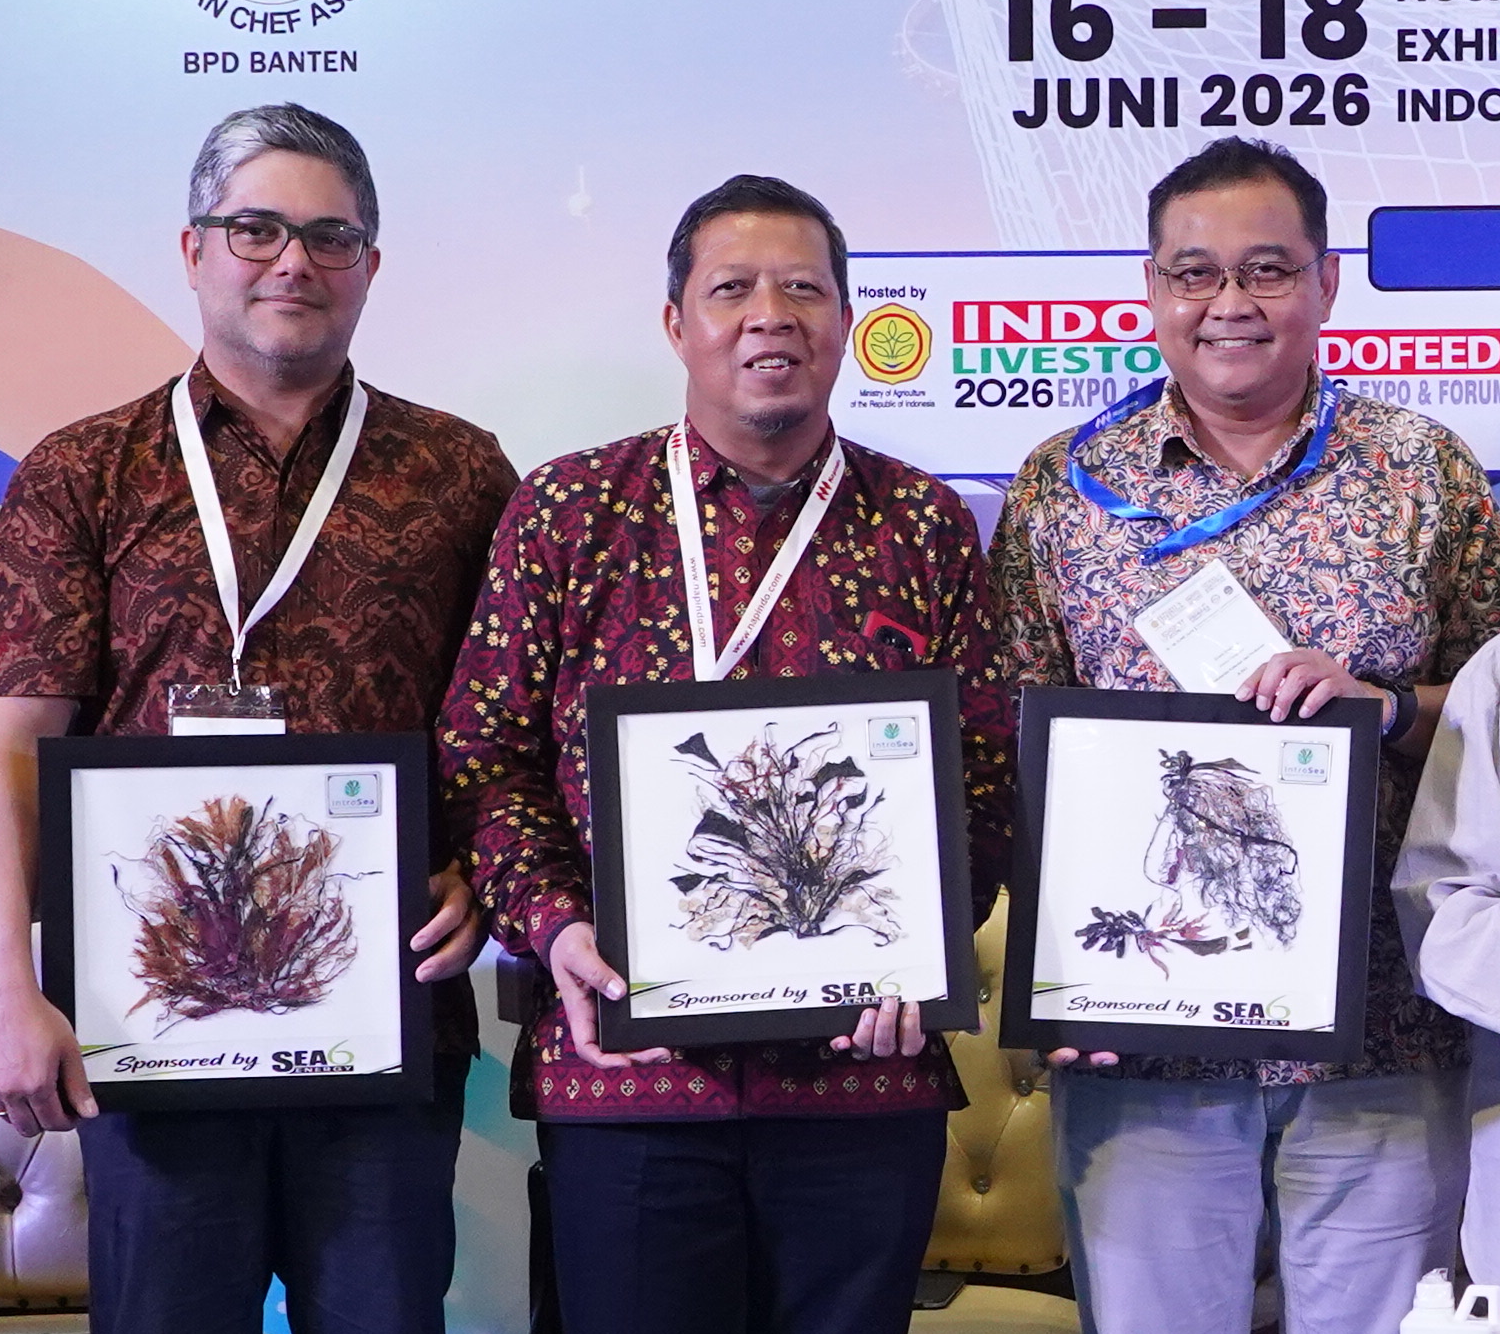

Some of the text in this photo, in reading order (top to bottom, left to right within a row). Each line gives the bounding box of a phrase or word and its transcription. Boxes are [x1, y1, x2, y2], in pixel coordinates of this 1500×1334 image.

[229, 6, 301, 35] CHEF
[183, 50, 358, 74] BPD BANTEN
[1012, 73, 1371, 129] JUNI 2026
[858, 286, 927, 300] Hosted by
[964, 303, 1154, 342] INDO
[953, 346, 1162, 374] LIVESTO
[955, 378, 1054, 408] 2026
[1058, 377, 1117, 407] EXPO
[1359, 380, 1411, 405] EXPO
[1418, 380, 1432, 405] &
[689, 556, 707, 648] www.napindo.com
[732, 572, 783, 654] www.napindo.com
[668, 989, 776, 1009] Sponsored
[782, 986, 807, 1005] by
[1066, 994, 1170, 1013] Sponsored
[1176, 1000, 1201, 1018] by
[114, 1053, 224, 1075] Sponsored
[232, 1053, 259, 1072] by
